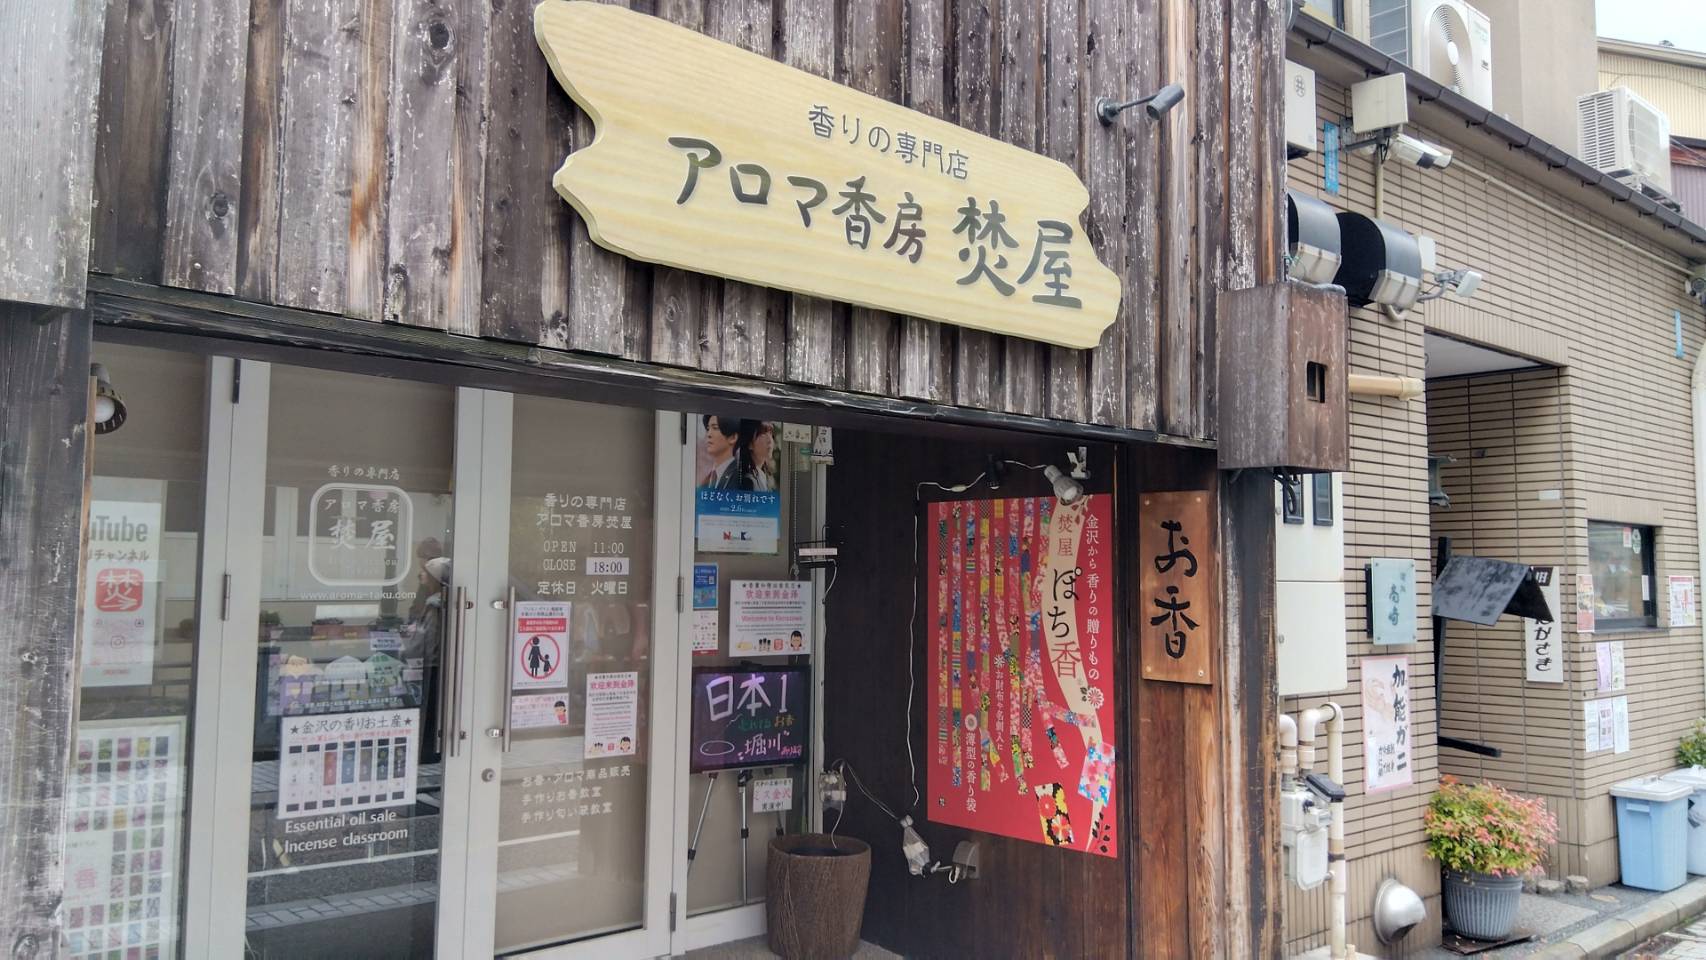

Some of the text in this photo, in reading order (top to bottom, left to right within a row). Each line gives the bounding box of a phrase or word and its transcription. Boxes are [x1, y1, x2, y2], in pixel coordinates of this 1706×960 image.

[807, 104, 970, 182] 香りの専門店
[667, 136, 1083, 310] アロマ香房 焚屋
[327, 464, 401, 481] 香りの専門店
[543, 492, 627, 511] 香りの専門店
[535, 513, 632, 529] アロマ香房焚屋
[543, 540, 624, 554] OPEN 11:00
[542, 558, 623, 573] CLOSE 18:00
[299, 590, 418, 600] www.aroma-taku.com
[536, 581, 628, 595] 定休日 火曜日
[1047, 513, 1083, 679] 焚屋 ぽち香
[1085, 513, 1100, 681] 金沢から香りの贈りもの
[1150, 519, 1200, 659] お香
[302, 714, 403, 735] 金沢の香りお土産
[1391, 663, 1408, 772] 加能ガニ
[964, 731, 978, 814] 薄型の香り袋
[284, 810, 397, 834] Essential oil sale
[284, 827, 408, 854] Incense classroom
